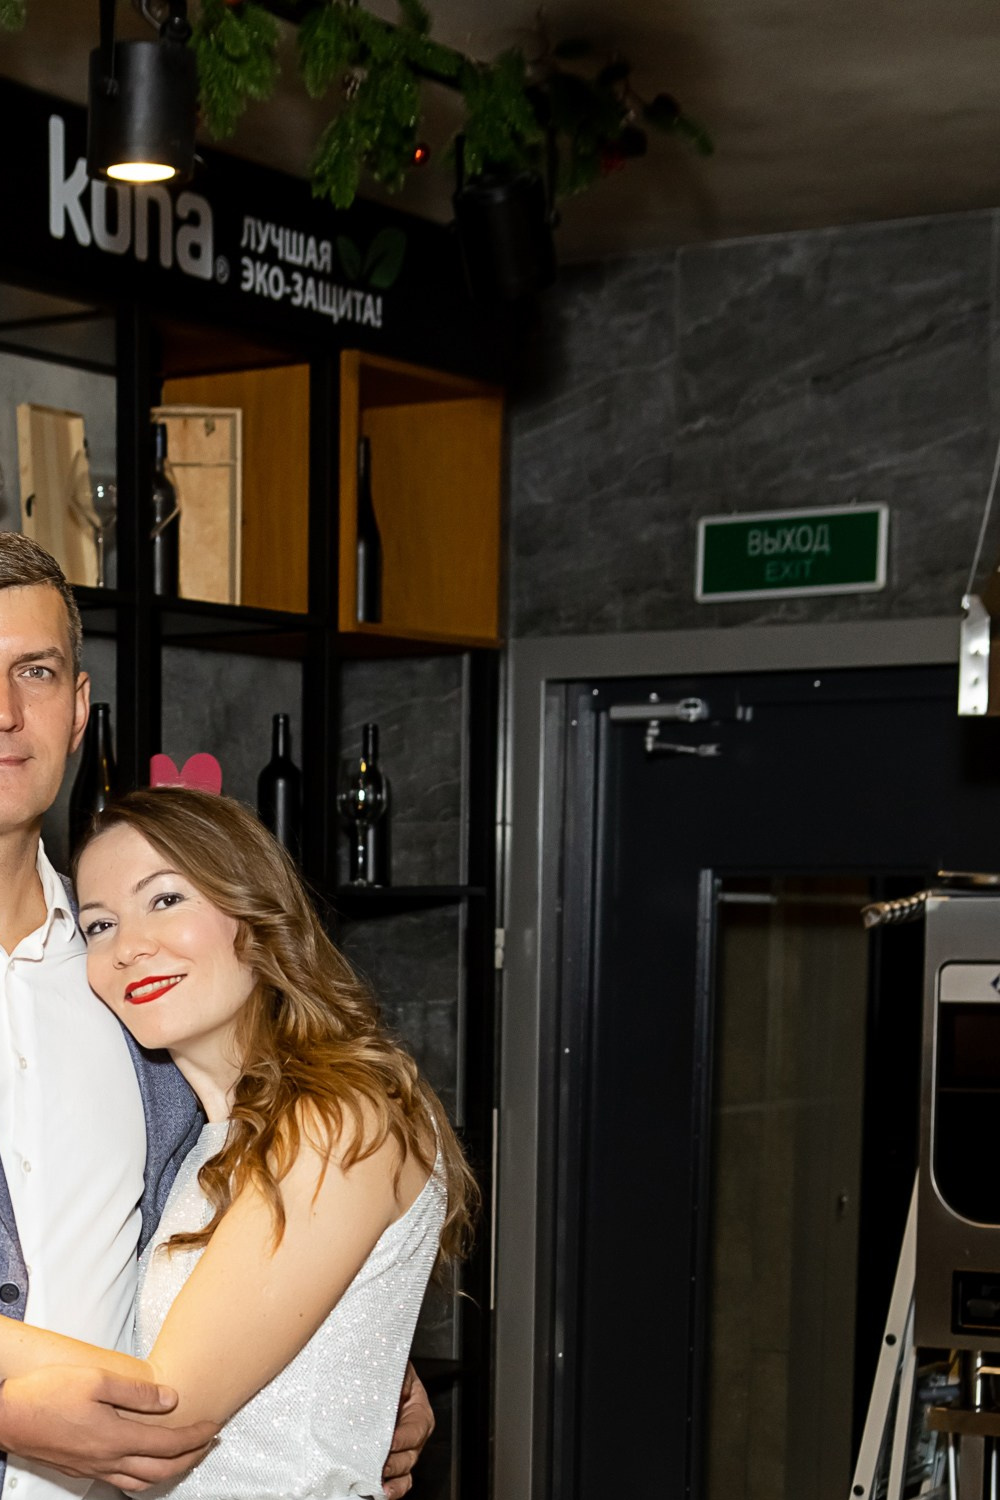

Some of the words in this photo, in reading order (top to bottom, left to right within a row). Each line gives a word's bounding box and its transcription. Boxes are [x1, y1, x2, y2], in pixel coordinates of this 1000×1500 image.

[240, 215, 332, 273] ЛУЧШАЯ
[240, 256, 383, 328] ЭКО-ЗАЩИТА!
[747, 524, 831, 557] ВЫХОД
[766, 560, 814, 581] EXIT
